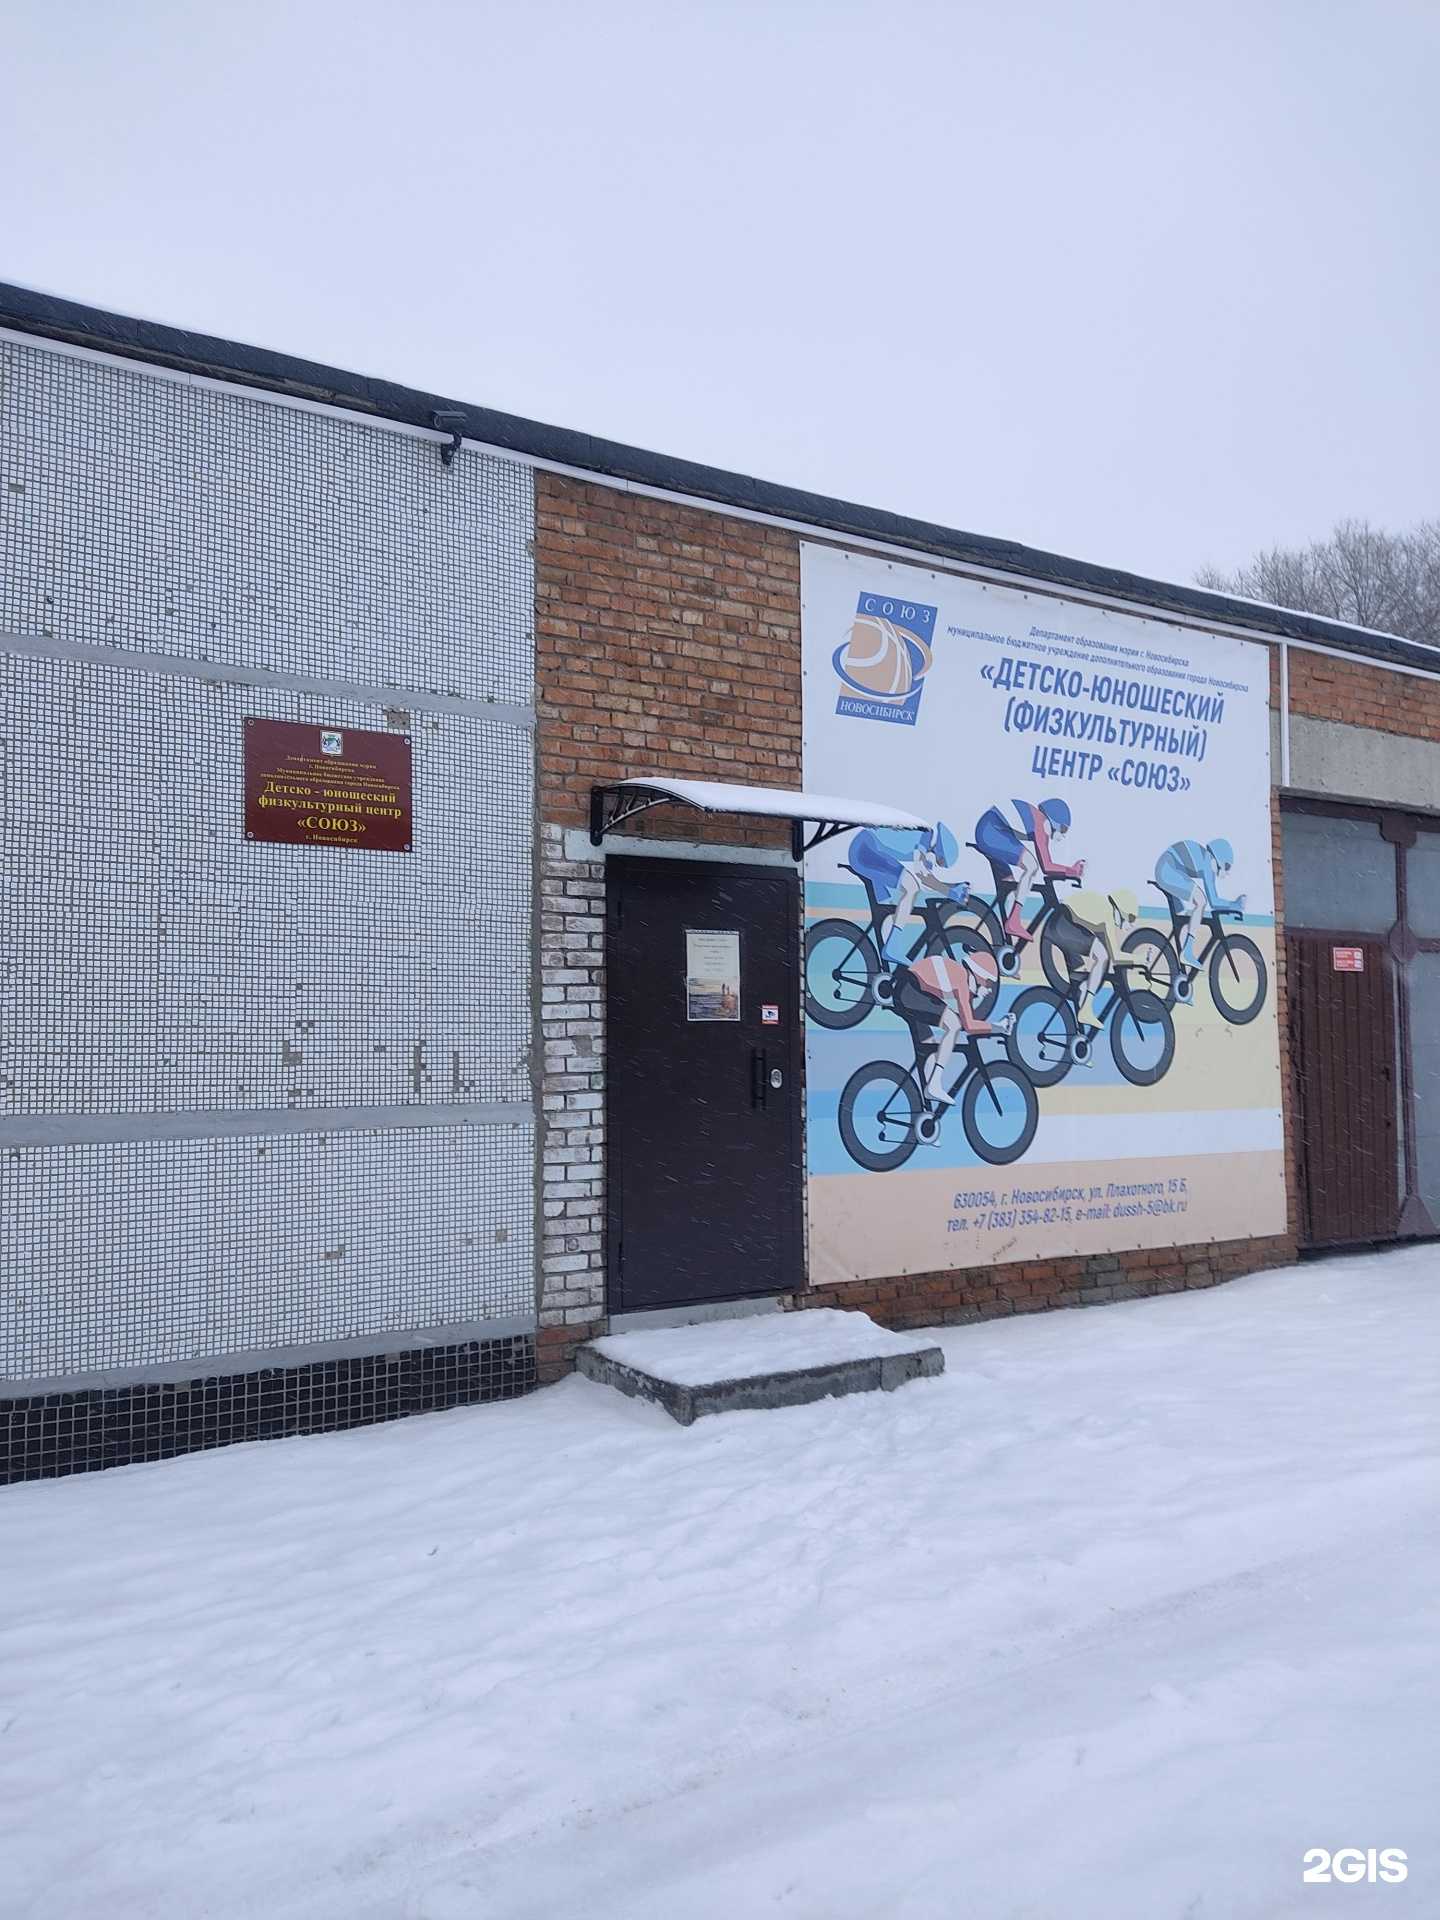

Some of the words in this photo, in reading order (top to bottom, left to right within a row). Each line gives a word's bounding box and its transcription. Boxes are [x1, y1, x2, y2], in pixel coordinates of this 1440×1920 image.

[865, 598, 931, 624] СОЮЗ
[1006, 636, 1047, 653] бюджетное
[1047, 645, 1090, 661] учреждение
[1089, 654, 1146, 672] дополнительного
[1146, 663, 1187, 680] образования
[1186, 673, 1208, 685] города
[1029, 626, 1076, 645] Департамент
[1075, 634, 1119, 653] образования
[1145, 648, 1190, 668] Новосибирска
[979, 657, 1225, 724] «ДЕТСКО-ЮНОШЕСКИЙ
[840, 700, 915, 721] НОВОСИБИРСК
[1003, 696, 1208, 762] (ФИЗКУЛЬТУРНЫЙ)
[1031, 745, 1103, 781] ЦЕНТР
[1107, 759, 1191, 792] «СОЮЗ»
[258, 795, 362, 814] физкультурный
[366, 805, 402, 821] центр
[264, 781, 311, 796] Детско
[323, 788, 396, 803] юношеский
[297, 816, 367, 833] «СОЮЗ»
[953, 1190, 998, 1210] 630054,
[1001, 1193, 1008, 1206] г.
[1088, 1186, 1103, 1203] ул.
[1168, 1178, 1179, 1194] 15
[947, 1218, 969, 1233] тел.
[973, 1212, 986, 1230] +7
[987, 1208, 1018, 1232] (383)
[1018, 1205, 1073, 1226] 354-82-15,
[1113, 1198, 1187, 1219] dussh-5@bk.ru
